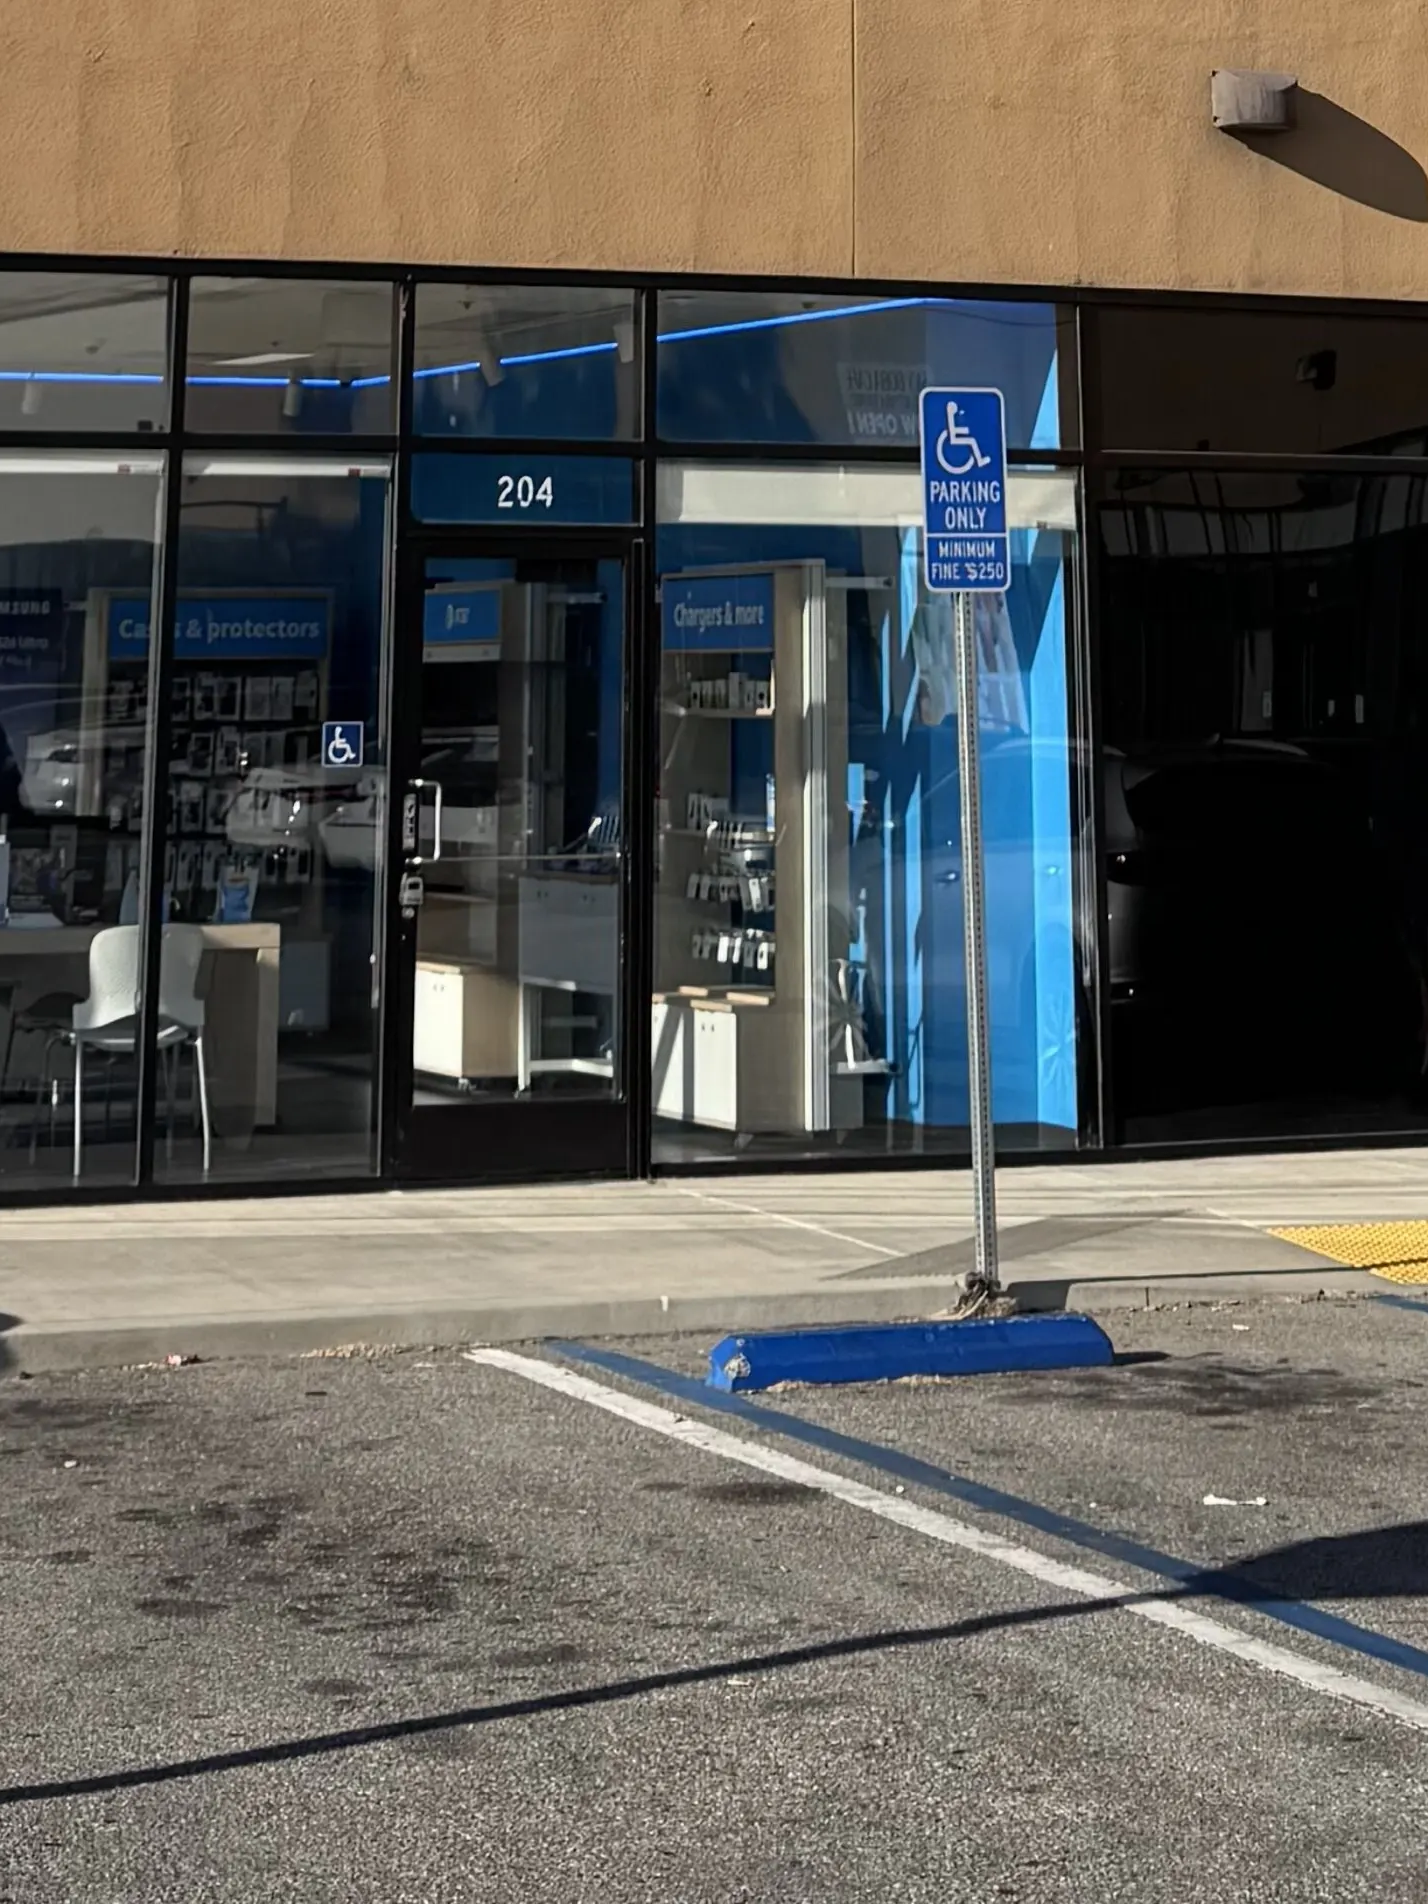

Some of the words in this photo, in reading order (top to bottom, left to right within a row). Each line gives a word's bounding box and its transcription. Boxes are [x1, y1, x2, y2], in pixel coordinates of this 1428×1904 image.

[497, 475, 554, 509] 204
[930, 480, 1001, 503] PARKING
[944, 507, 987, 529] ONLY
[938, 540, 996, 558] MINIMUM
[931, 562, 961, 581] FINE
[965, 562, 1005, 581] $250
[674, 602, 723, 633] Chargers
[724, 601, 734, 626] &
[735, 604, 765, 626] more
[118, 618, 181, 639] Cas
[185, 618, 203, 638] &
[206, 619, 320, 644] protectors
